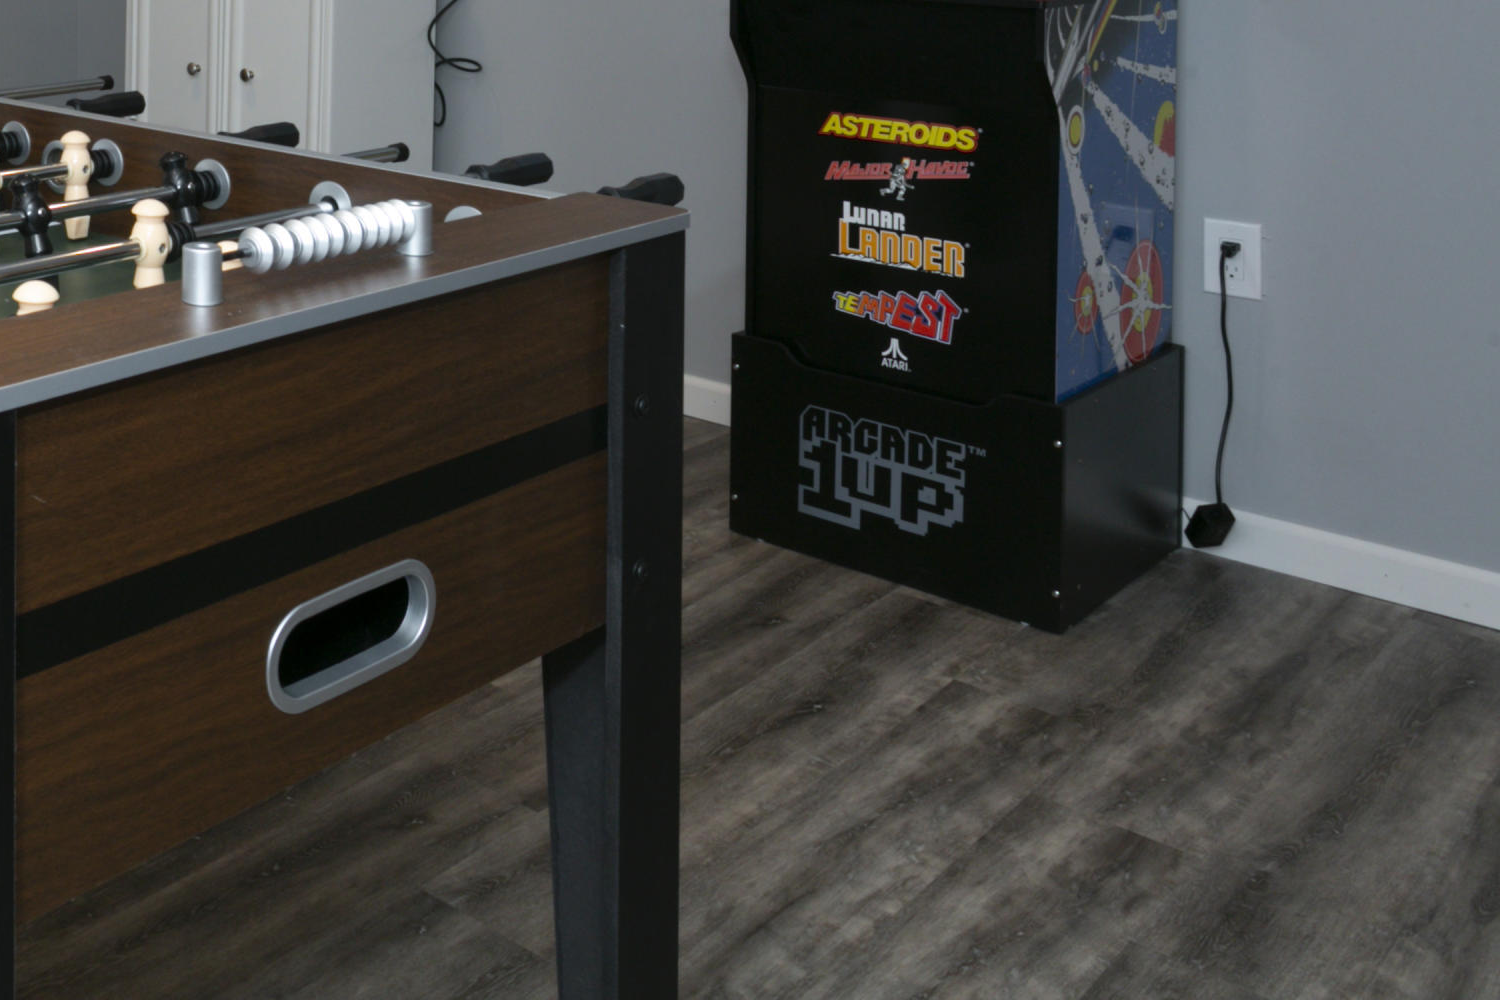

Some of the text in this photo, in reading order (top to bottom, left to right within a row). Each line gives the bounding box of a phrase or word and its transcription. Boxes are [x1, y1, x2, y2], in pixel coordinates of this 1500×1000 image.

[820, 113, 977, 152] ASTEROIDS
[839, 218, 965, 278] LANDER
[832, 290, 962, 344] TEMPEST
[881, 358, 908, 371] ATARI
[799, 404, 966, 484] ARCADE
